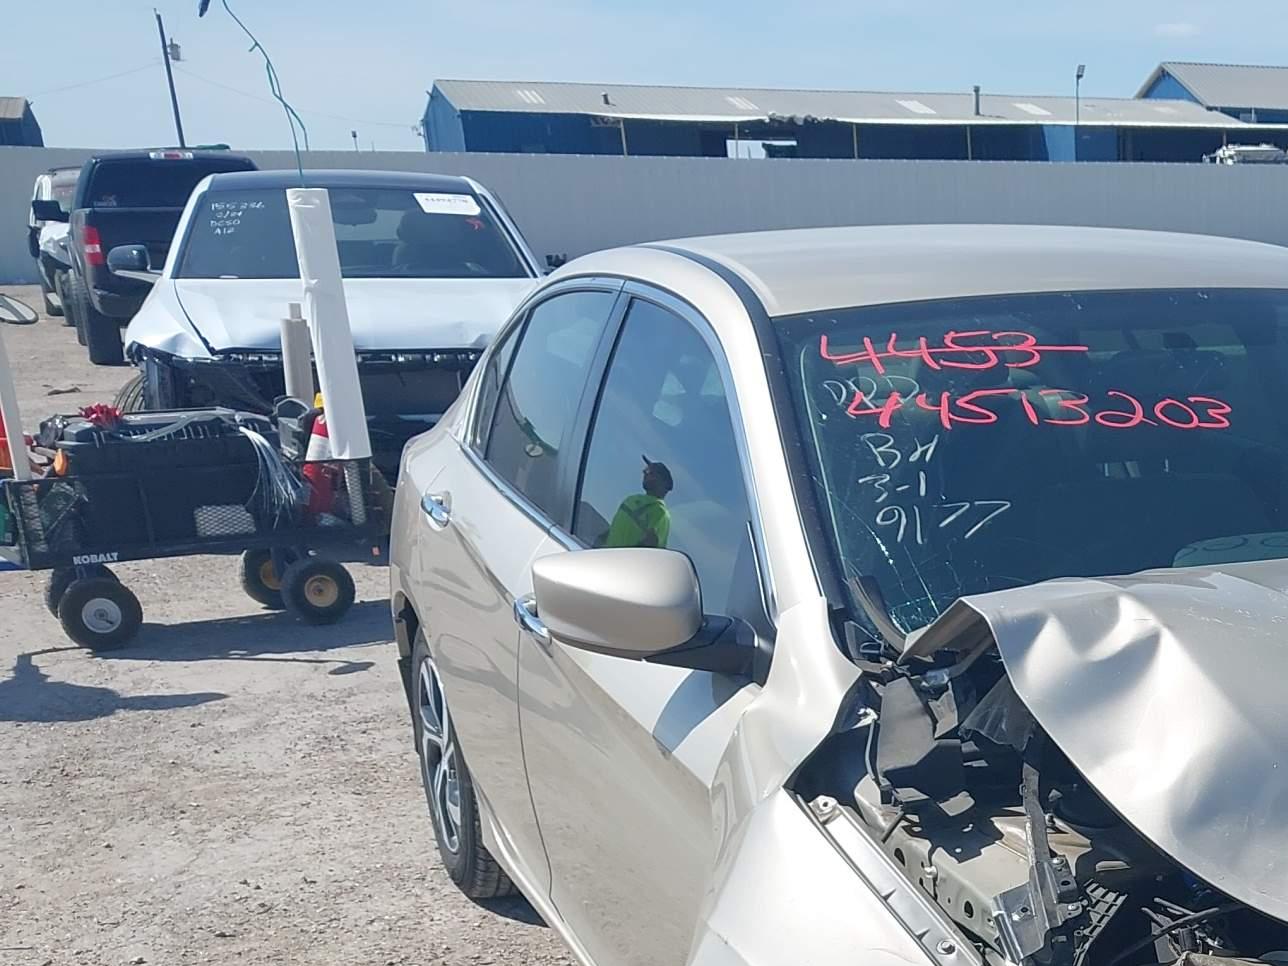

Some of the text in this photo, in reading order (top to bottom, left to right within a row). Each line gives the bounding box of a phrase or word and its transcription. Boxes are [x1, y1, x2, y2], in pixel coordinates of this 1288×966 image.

[820, 330, 1042, 374] 4453
[847, 387, 1232, 430] 44513203
[876, 495, 1012, 545] 9177
[73, 552, 119, 565] KOBALT
